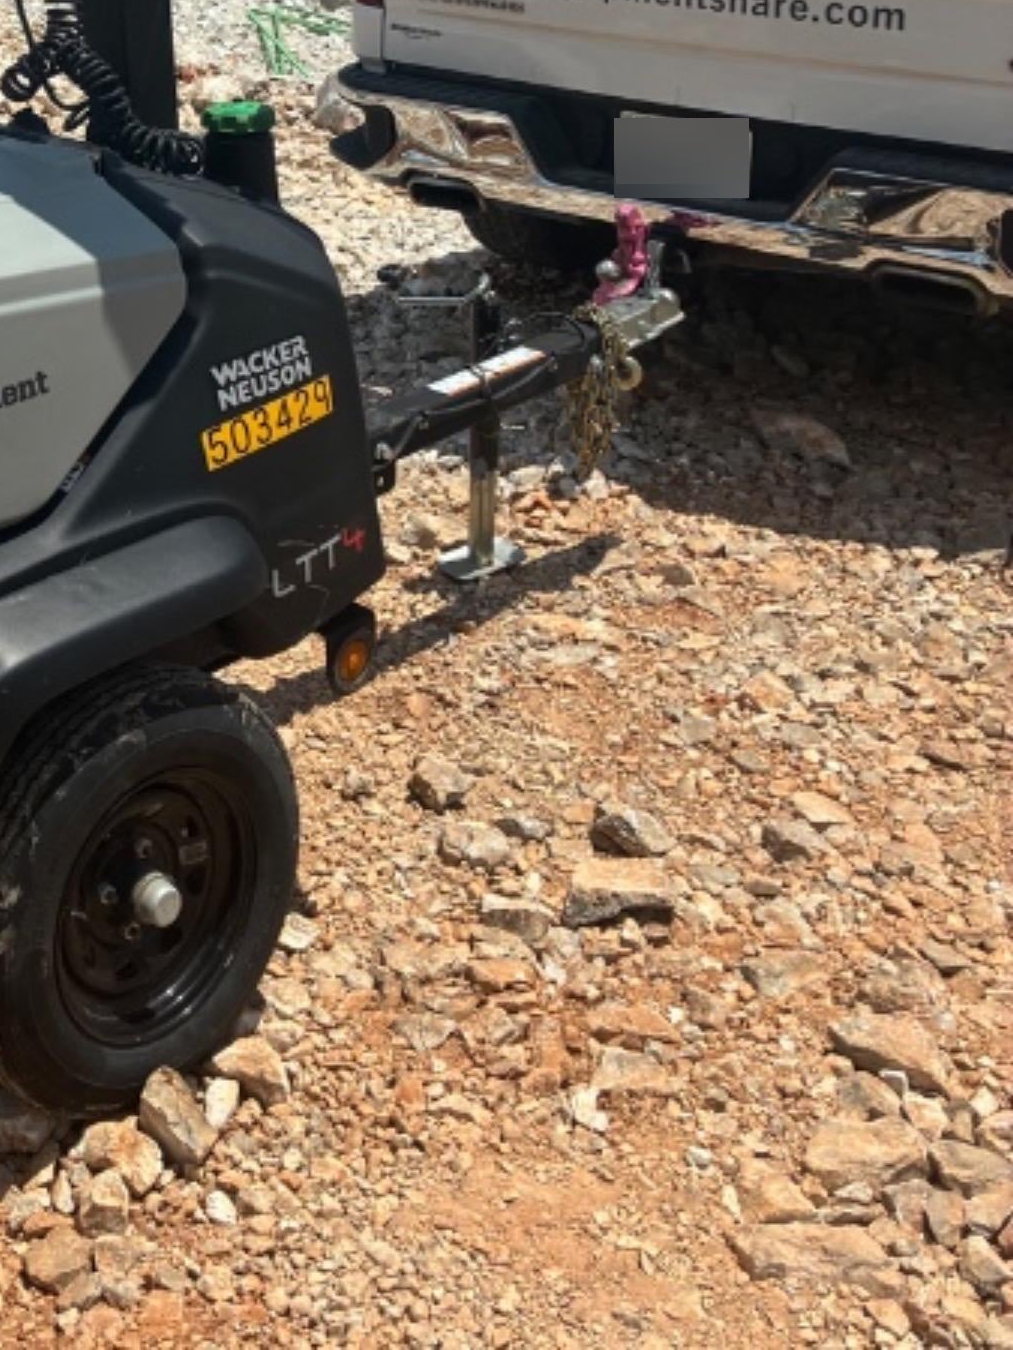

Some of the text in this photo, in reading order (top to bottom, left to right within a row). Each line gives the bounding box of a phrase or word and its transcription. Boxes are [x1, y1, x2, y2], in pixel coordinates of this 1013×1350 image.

[210, 334, 309, 388] WACKER
[217, 356, 313, 411] NEUSON
[207, 379, 332, 465] 503429
